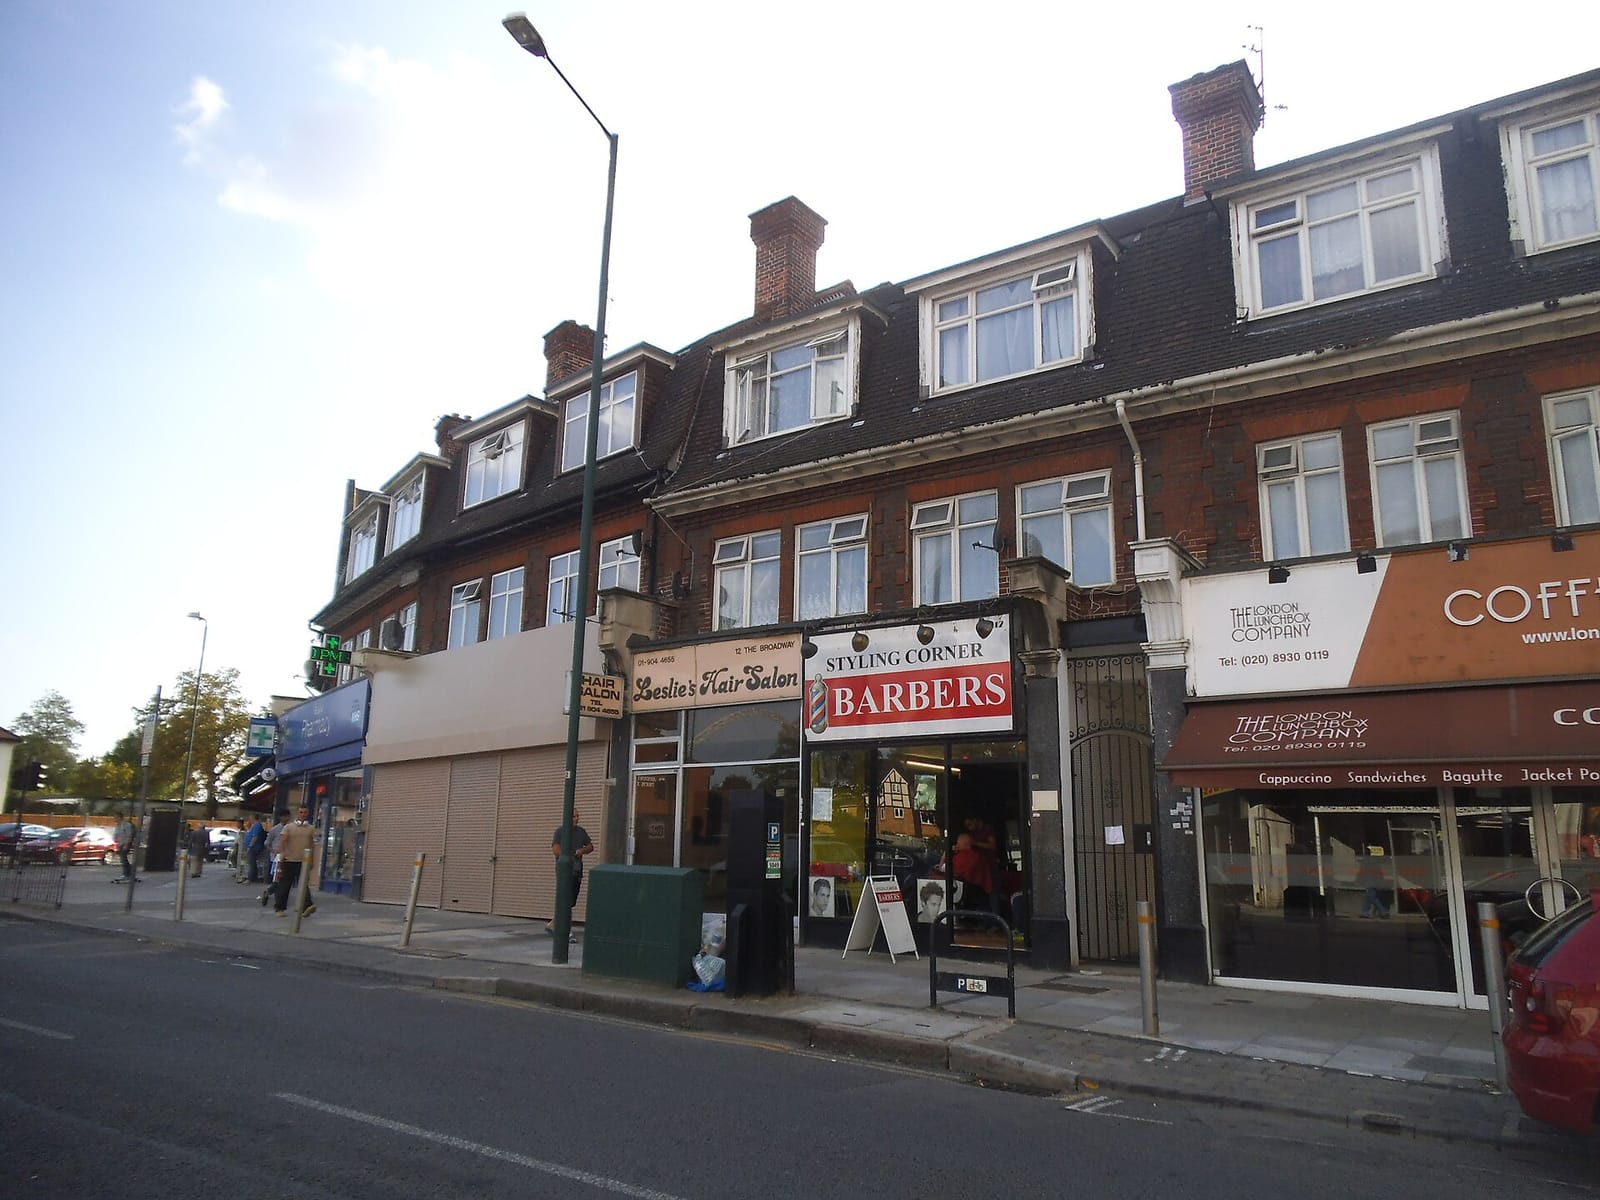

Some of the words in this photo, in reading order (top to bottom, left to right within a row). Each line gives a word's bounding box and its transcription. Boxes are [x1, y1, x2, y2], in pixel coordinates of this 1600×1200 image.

[1443, 577, 1600, 626] COFF
[1230, 607, 1254, 629] THE
[1253, 603, 1299, 617] LONDON
[1253, 612, 1311, 627] LUNCHBOX
[1231, 624, 1311, 643] COMPANY
[735, 647, 742, 655] 12
[744, 646, 757, 654] THE
[760, 641, 796, 652] BROADWAY
[826, 651, 900, 672] STYLING
[905, 642, 984, 664] CORNER
[1219, 656, 1238, 667] Tel:
[1241, 654, 1269, 668] (020)
[1272, 652, 1301, 663] 8930
[1304, 650, 1329, 661] 0119
[582, 675, 615, 689] HAIR
[633, 675, 697, 702] Leslie's
[699, 668, 744, 696] Hair
[744, 665, 799, 691] Salon
[832, 673, 1007, 717] BARBERS
[1236, 715, 1275, 733] THE
[1275, 711, 1353, 724] LONDON
[1272, 719, 1369, 732] LUNCHBOX
[1229, 728, 1368, 744] COMPANY
[1284, 742, 1323, 750] 8930
[1327, 741, 1367, 749] 0119
[1259, 773, 1332, 786] Cappuccino
[1347, 771, 1427, 784] Sandwiches
[1443, 769, 1504, 785] Bagutte
[1520, 768, 1573, 782] Jacket
[957, 979, 966, 989] P
